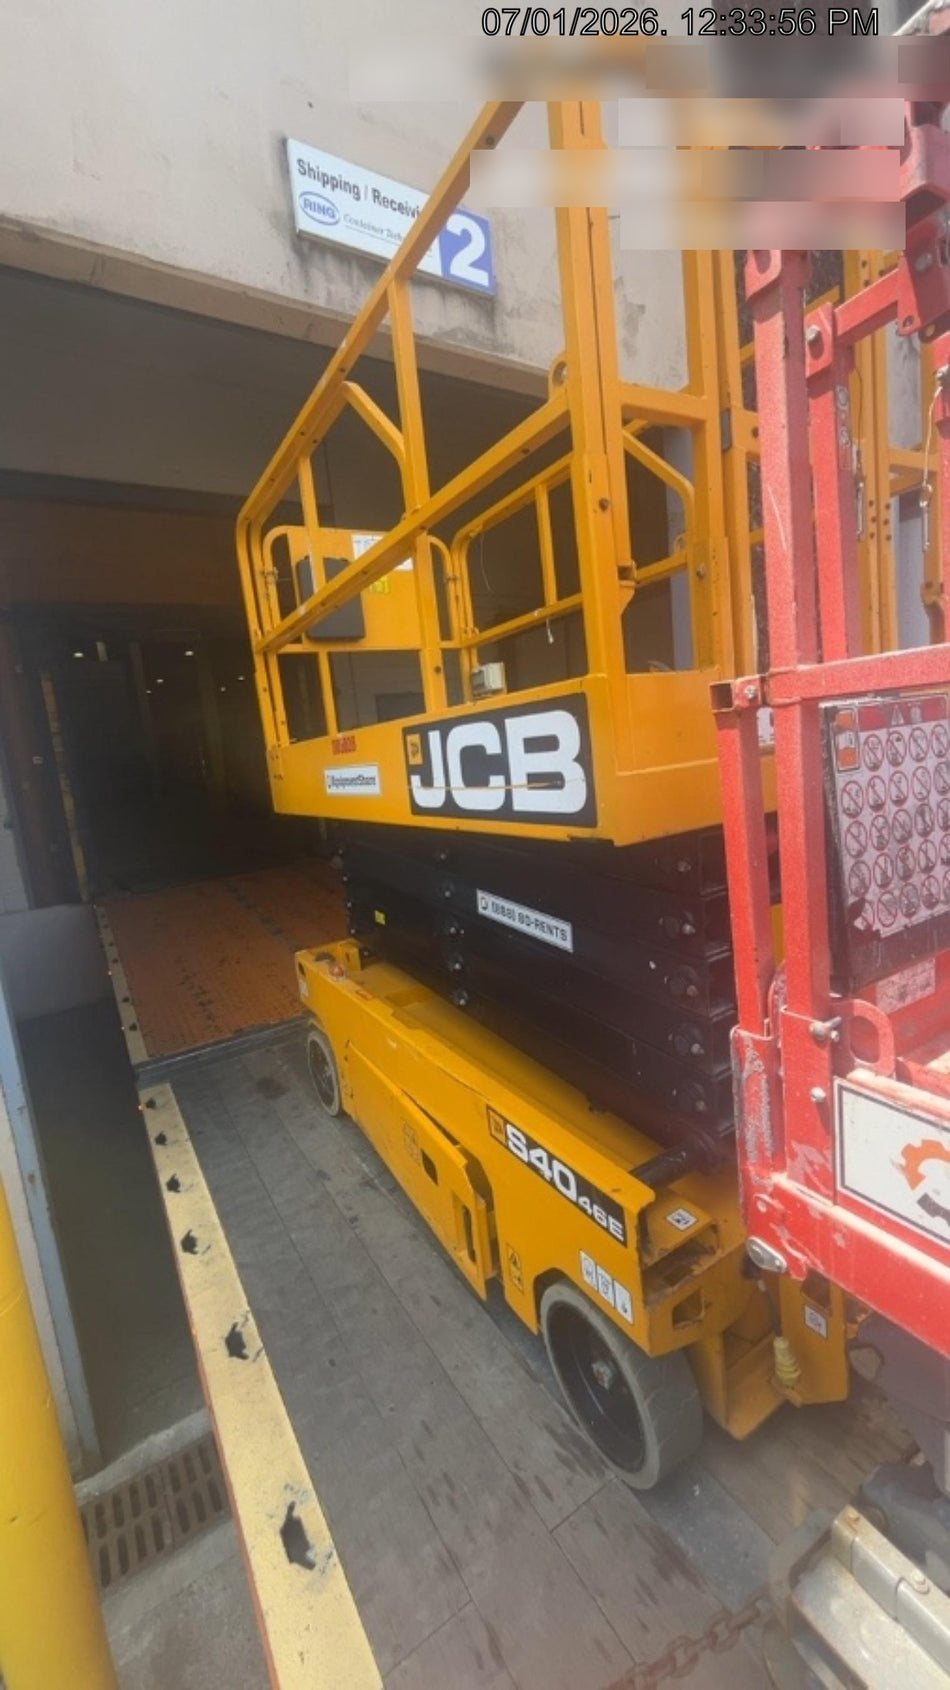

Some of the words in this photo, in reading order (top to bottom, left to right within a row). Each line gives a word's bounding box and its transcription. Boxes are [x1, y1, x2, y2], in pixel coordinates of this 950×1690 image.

[296, 157, 361, 202] Shipping
[371, 187, 420, 218] Receivi
[303, 197, 336, 219] RING
[446, 213, 489, 288] 2
[410, 709, 588, 814] JCB
